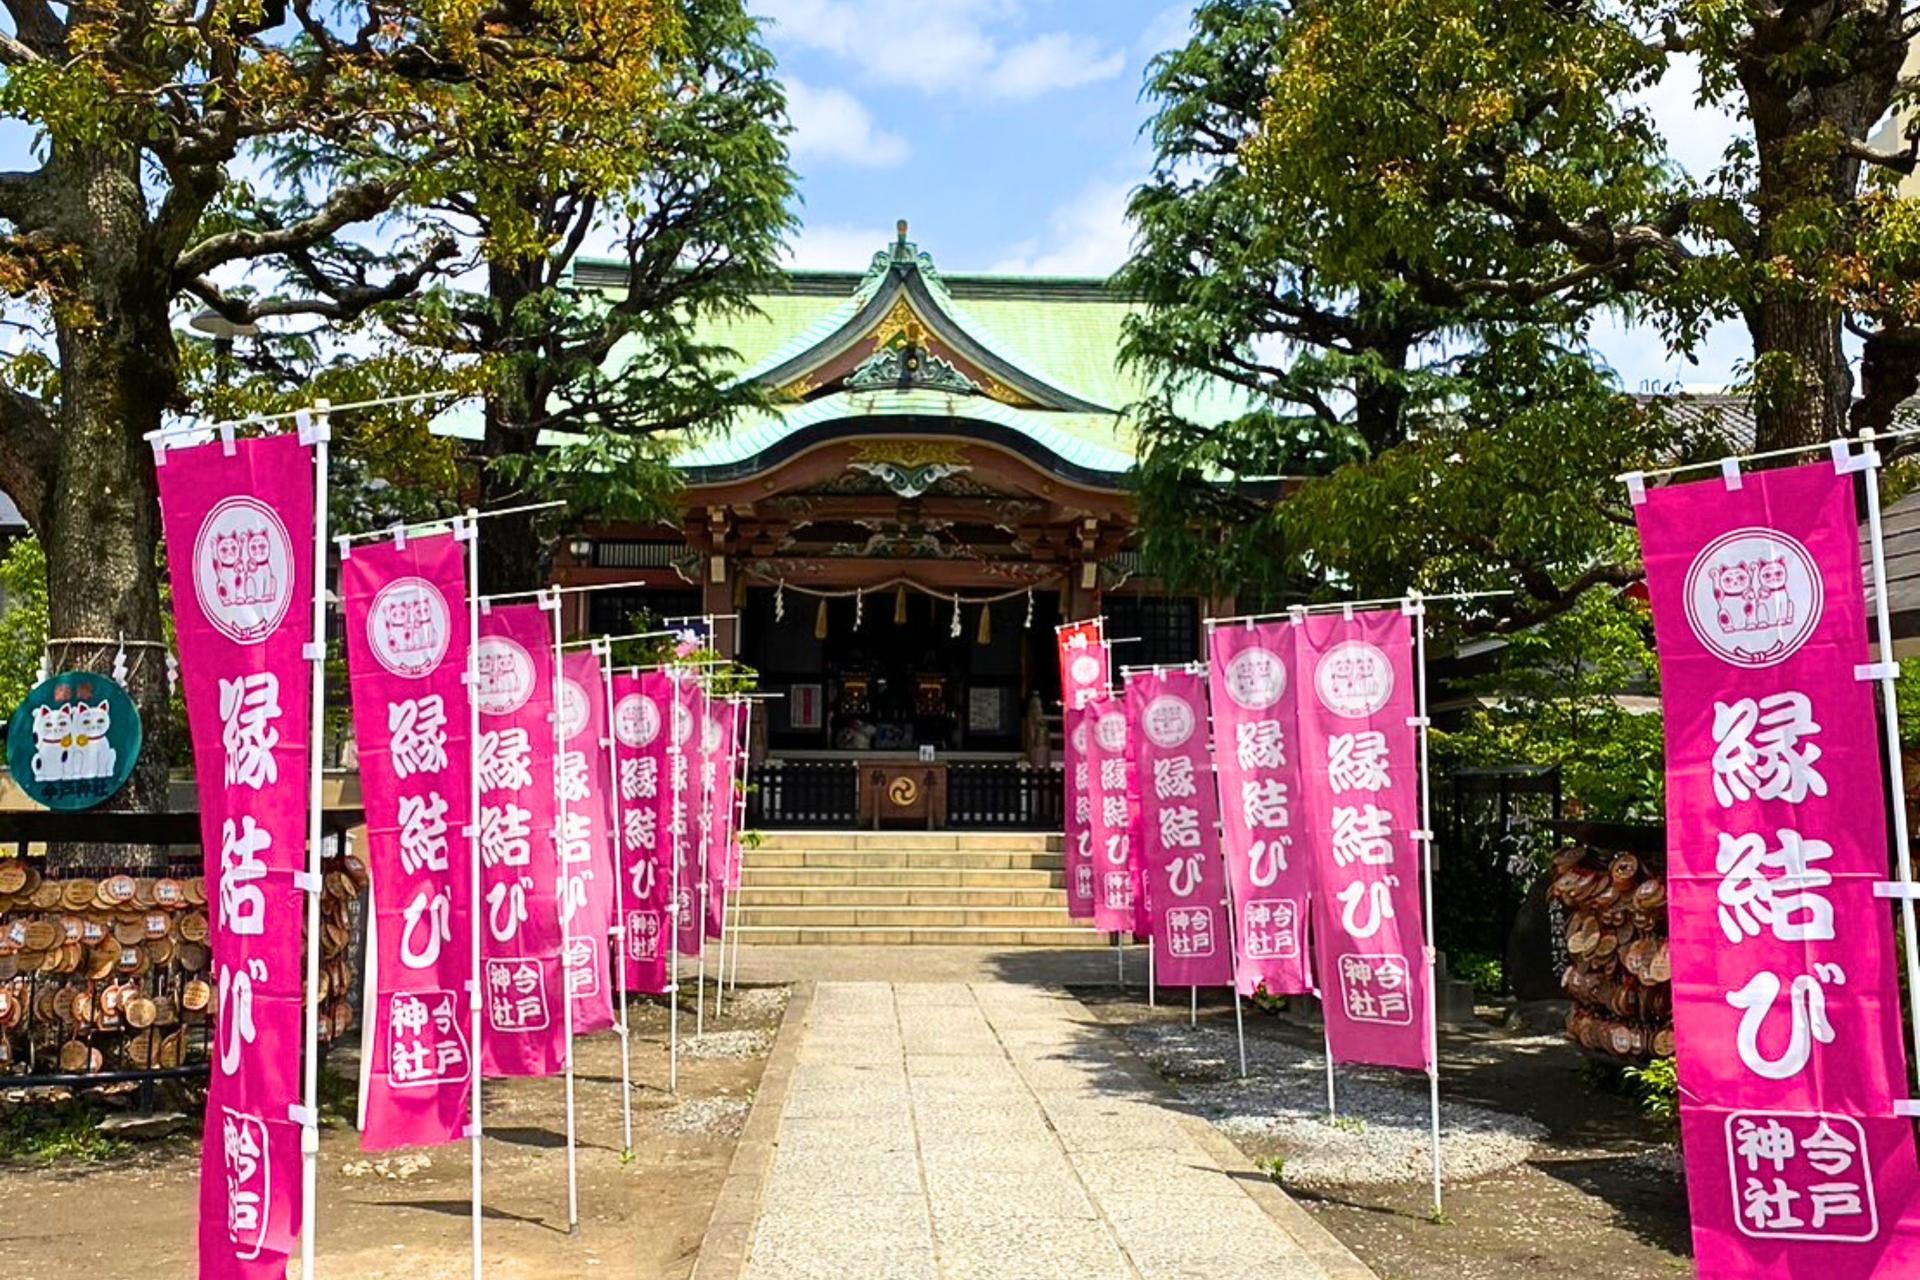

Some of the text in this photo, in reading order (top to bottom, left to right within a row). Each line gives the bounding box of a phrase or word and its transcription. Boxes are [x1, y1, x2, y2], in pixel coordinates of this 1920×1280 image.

[387, 694, 452, 969] 縁結び
[479, 727, 534, 943] 縁結び
[621, 756, 658, 899] 縁結び
[1153, 756, 1206, 898] 縁結び
[1236, 719, 1291, 888] 縁結び
[1328, 731, 1399, 939] 縁結び
[1168, 910, 1190, 953] 神社
[1190, 910, 1209, 953] 今戸
[1246, 904, 1271, 955] 神社
[1271, 903, 1294, 954] 今戸
[1711, 690, 1845, 1080] 縁結び
[491, 963, 515, 1025] 神社
[512, 964, 541, 1025] 今戸
[1343, 958, 1378, 1018] 神社
[1375, 959, 1406, 1018] 今戸
[392, 996, 432, 1080] 神社
[1737, 1117, 1802, 1233] 神社
[1800, 1122, 1861, 1232] 今戸
